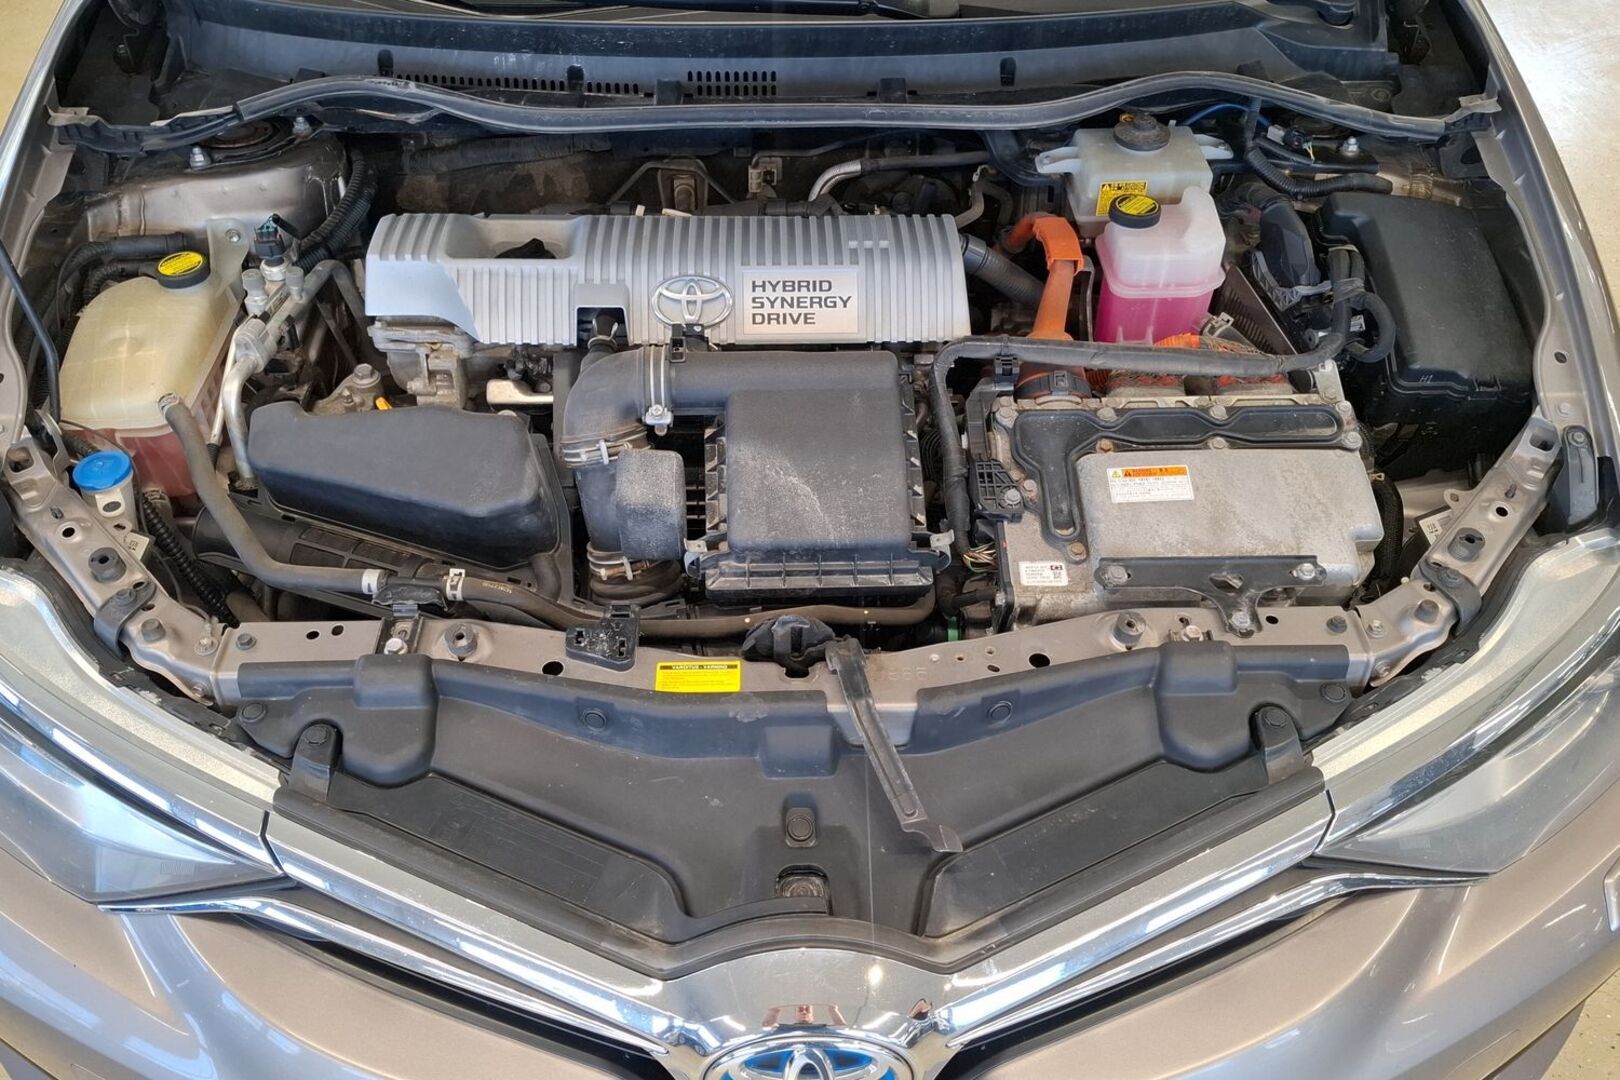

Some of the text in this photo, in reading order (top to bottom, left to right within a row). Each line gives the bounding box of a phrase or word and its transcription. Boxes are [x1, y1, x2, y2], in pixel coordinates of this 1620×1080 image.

[751, 280, 832, 293] HYBRID
[751, 296, 852, 309] SYNERGY
[751, 312, 816, 325] DRIVE
